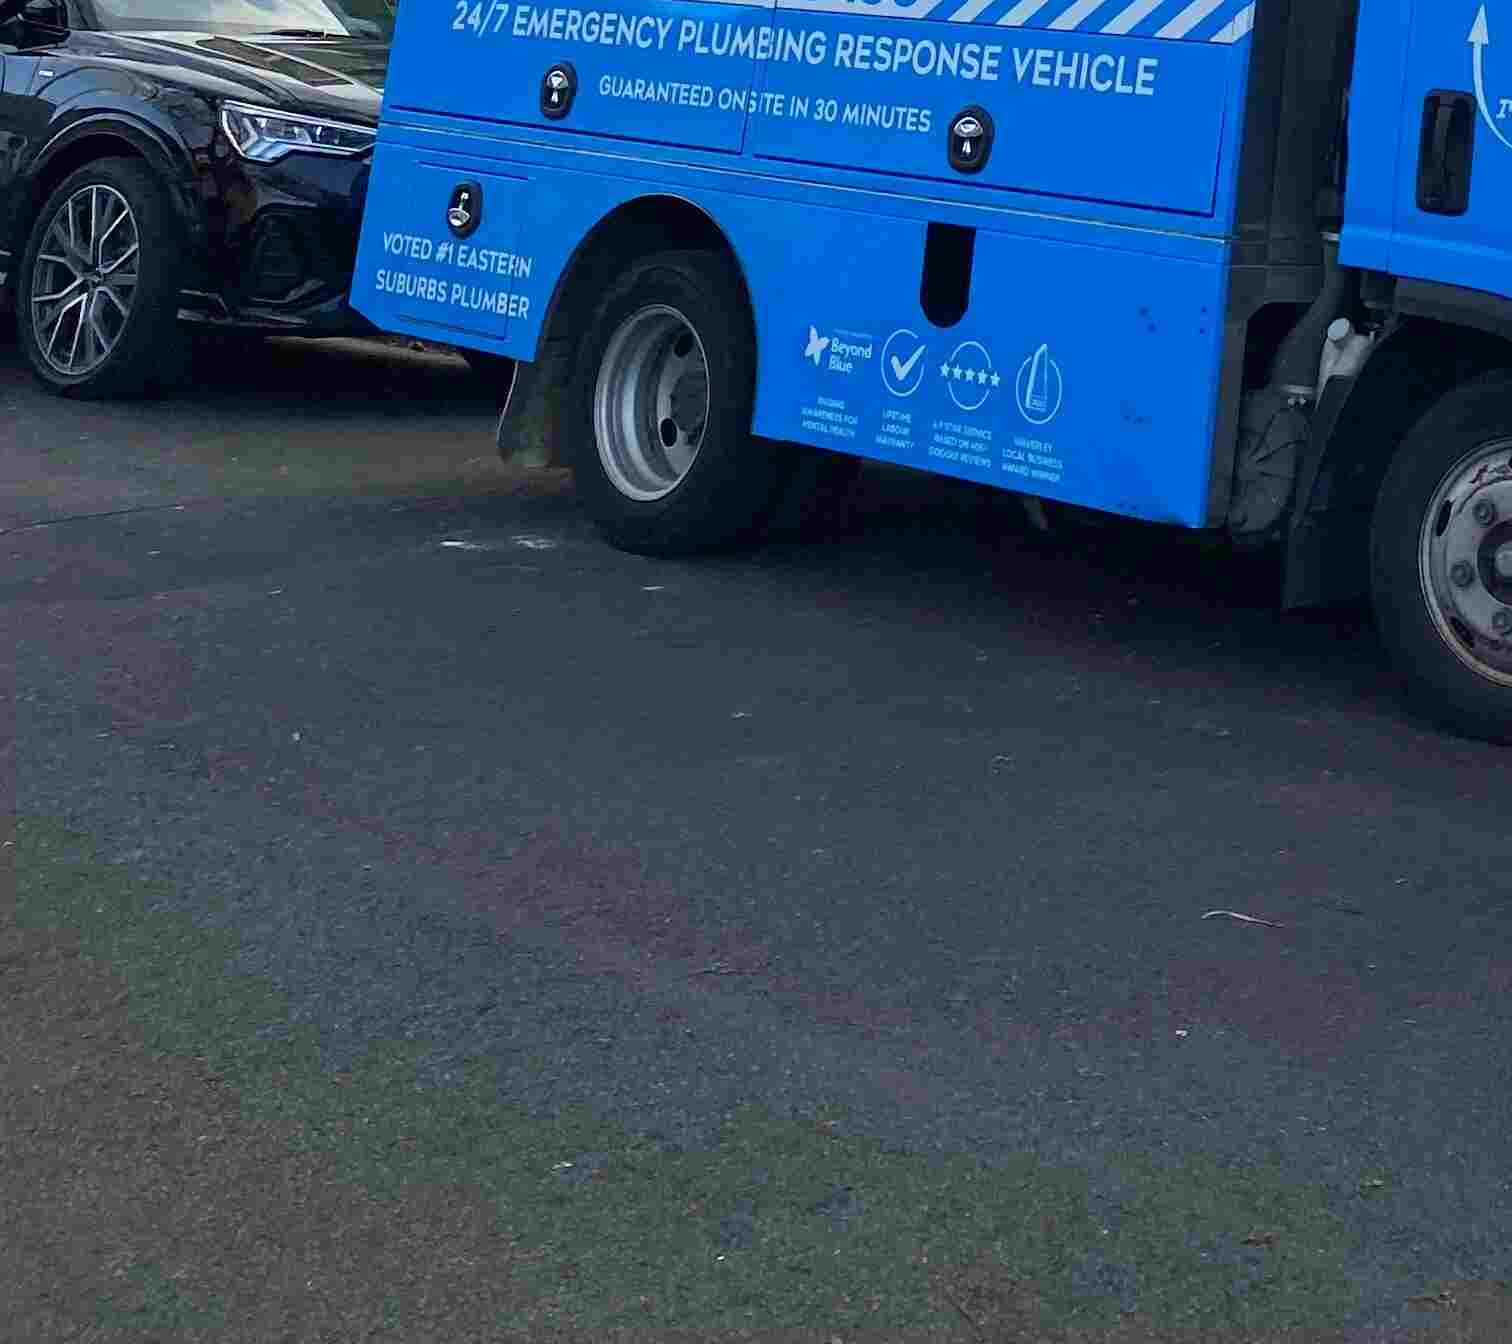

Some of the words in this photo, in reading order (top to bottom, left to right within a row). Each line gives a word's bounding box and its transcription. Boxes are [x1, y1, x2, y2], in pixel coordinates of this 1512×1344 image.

[452, 0, 508, 39] 24/7
[512, 5, 673, 51] EMERGENCY
[678, 20, 826, 64] PLUMBING
[834, 33, 1002, 81] RESPONSE
[1012, 47, 1159, 95] VEHICLE
[599, 74, 714, 108] GUARANTEED
[789, 95, 809, 119] IN
[814, 98, 838, 123] 30
[841, 102, 932, 132] MINUTES
[383, 232, 432, 260] VOTED
[457, 244, 533, 278] EASTERN
[375, 269, 448, 303] SUBURBS
[450, 283, 530, 320] PLUMBER
[828, 354, 854, 373] Blue
[831, 337, 872, 359] Beyond
